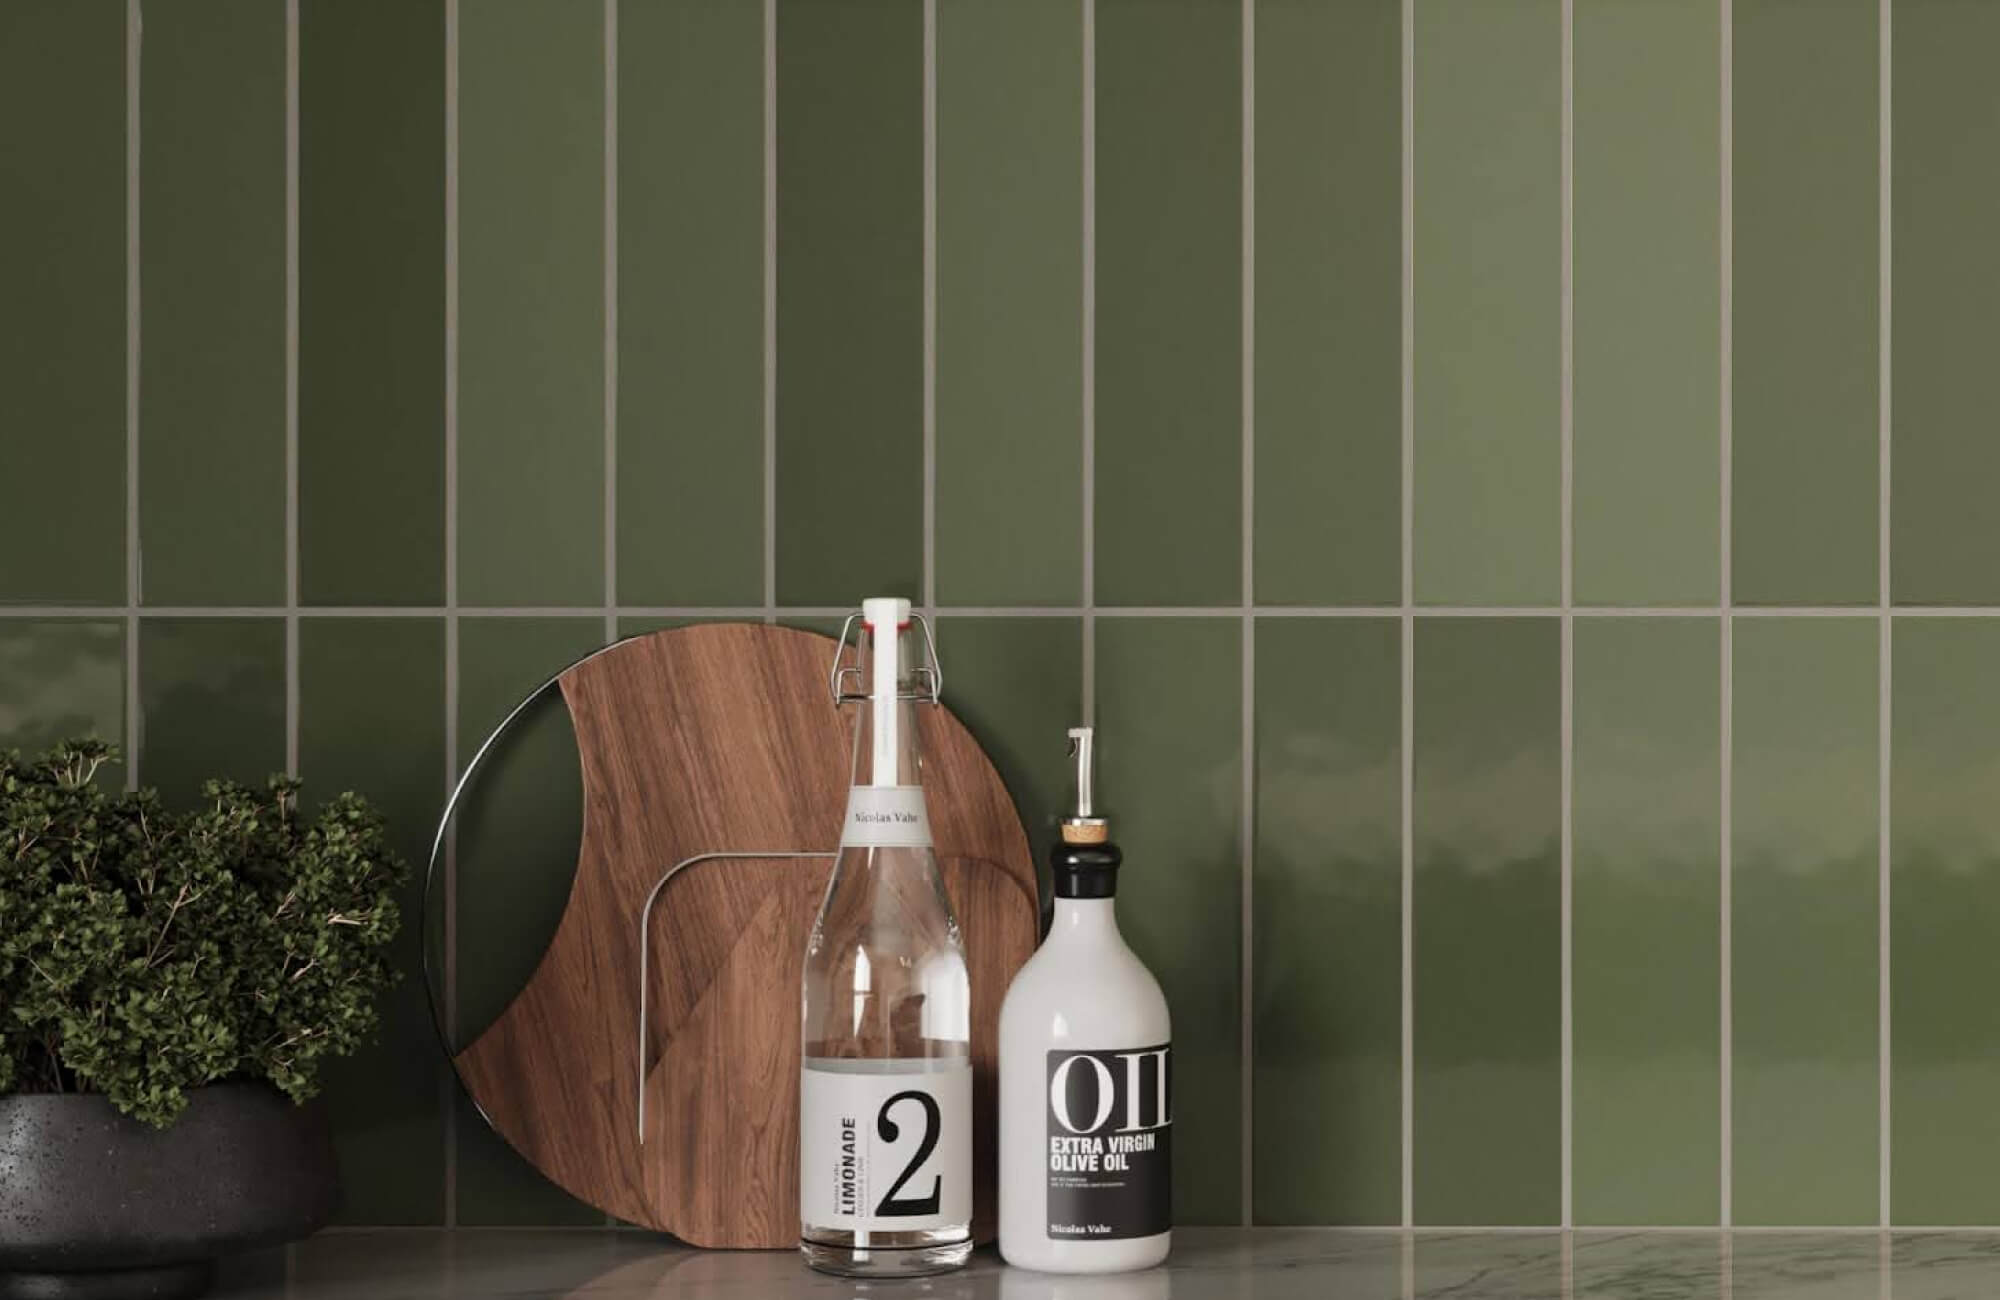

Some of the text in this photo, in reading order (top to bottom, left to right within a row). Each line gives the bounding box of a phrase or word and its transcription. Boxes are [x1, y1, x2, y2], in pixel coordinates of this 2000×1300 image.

[841, 1117, 856, 1216] LIMONADE
[874, 1090, 942, 1217] 2
[1050, 1153, 1130, 1172] OLIVE OIL
[1051, 1132, 1156, 1155] EXTRA VIRGIN
